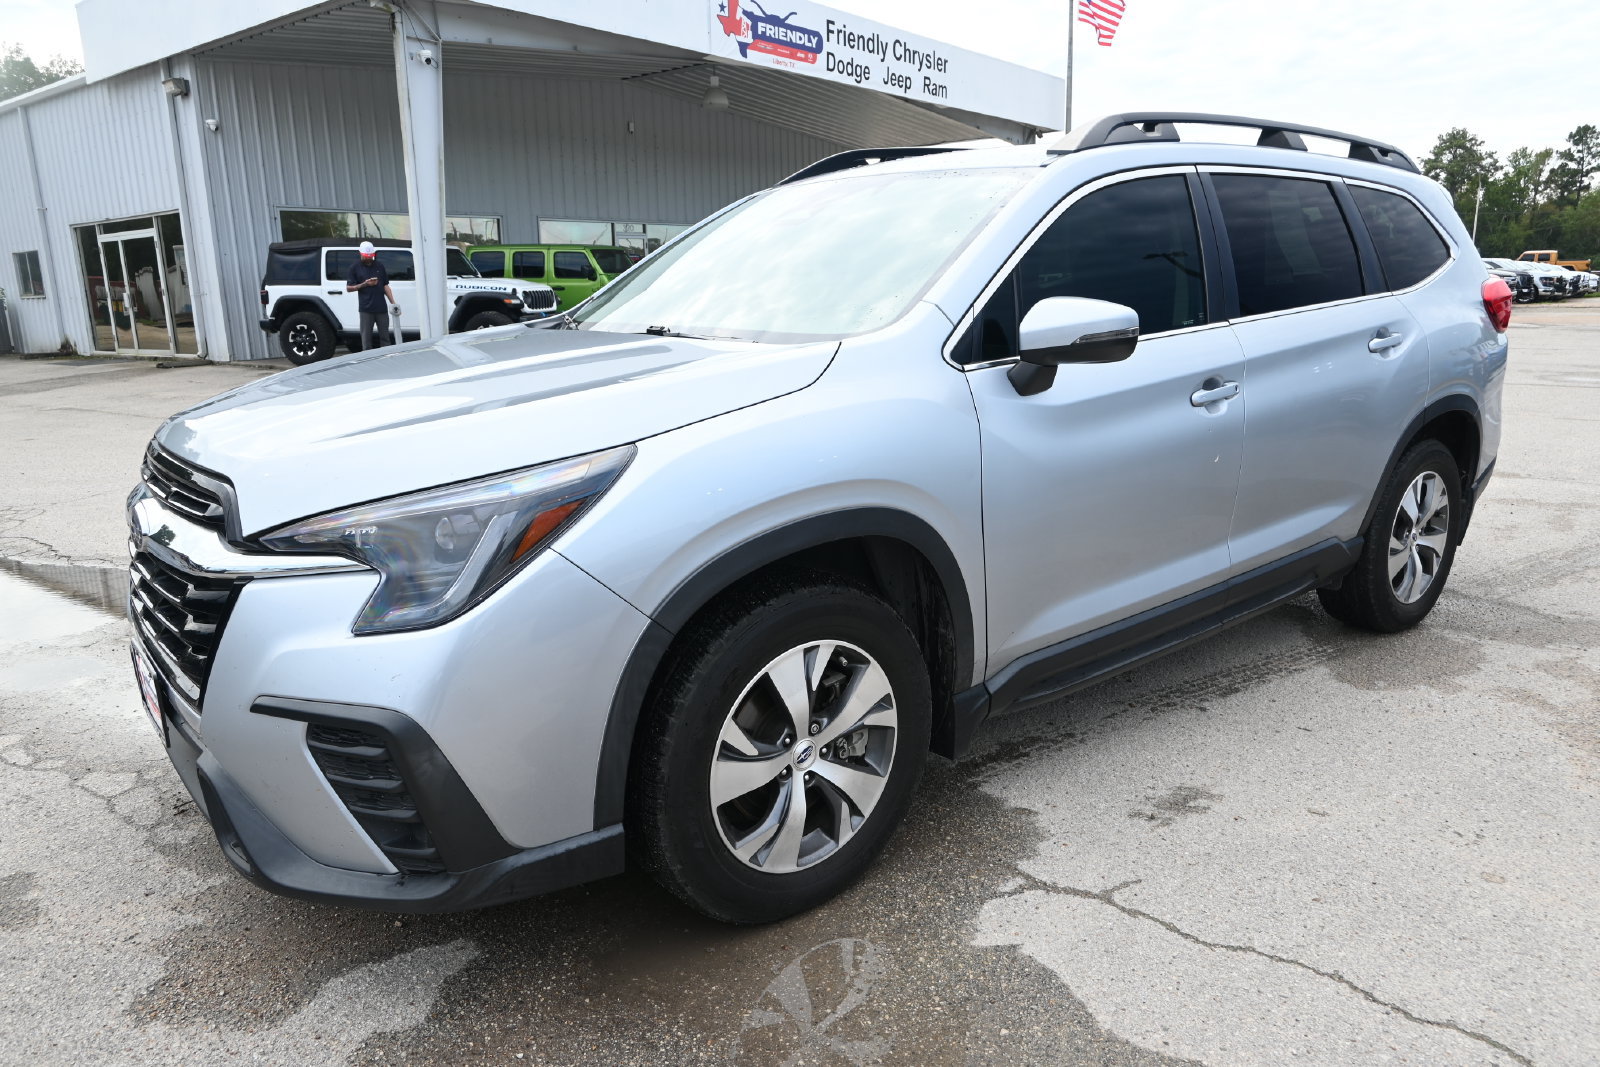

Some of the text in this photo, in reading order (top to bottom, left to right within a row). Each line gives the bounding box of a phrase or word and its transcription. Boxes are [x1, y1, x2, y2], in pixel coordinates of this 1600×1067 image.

[757, 21, 818, 48] FRIENDLY
[826, 19, 948, 73] Friendly Chrysler
[826, 51, 947, 99] Dodge Jeep Ram
